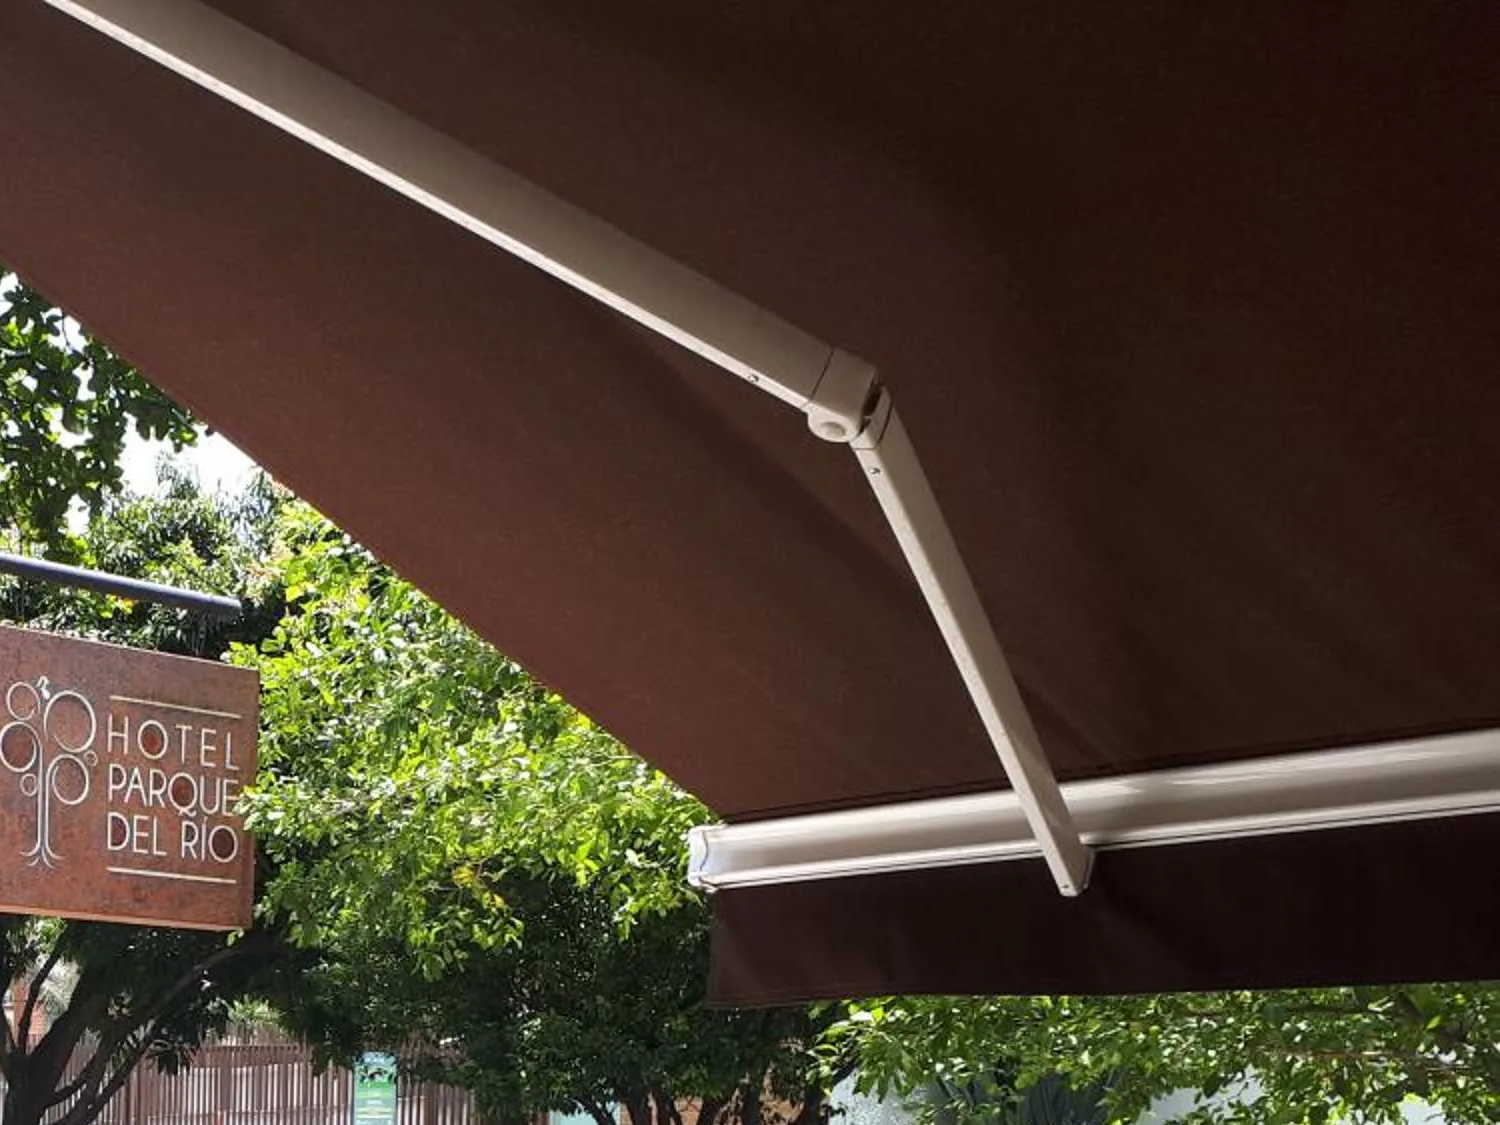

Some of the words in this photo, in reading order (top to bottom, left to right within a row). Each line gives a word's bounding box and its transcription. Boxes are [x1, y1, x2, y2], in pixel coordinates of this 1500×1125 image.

[107, 714, 240, 770] HOTEL
[107, 763, 240, 817] PARQUE
[106, 811, 167, 857] DEL
